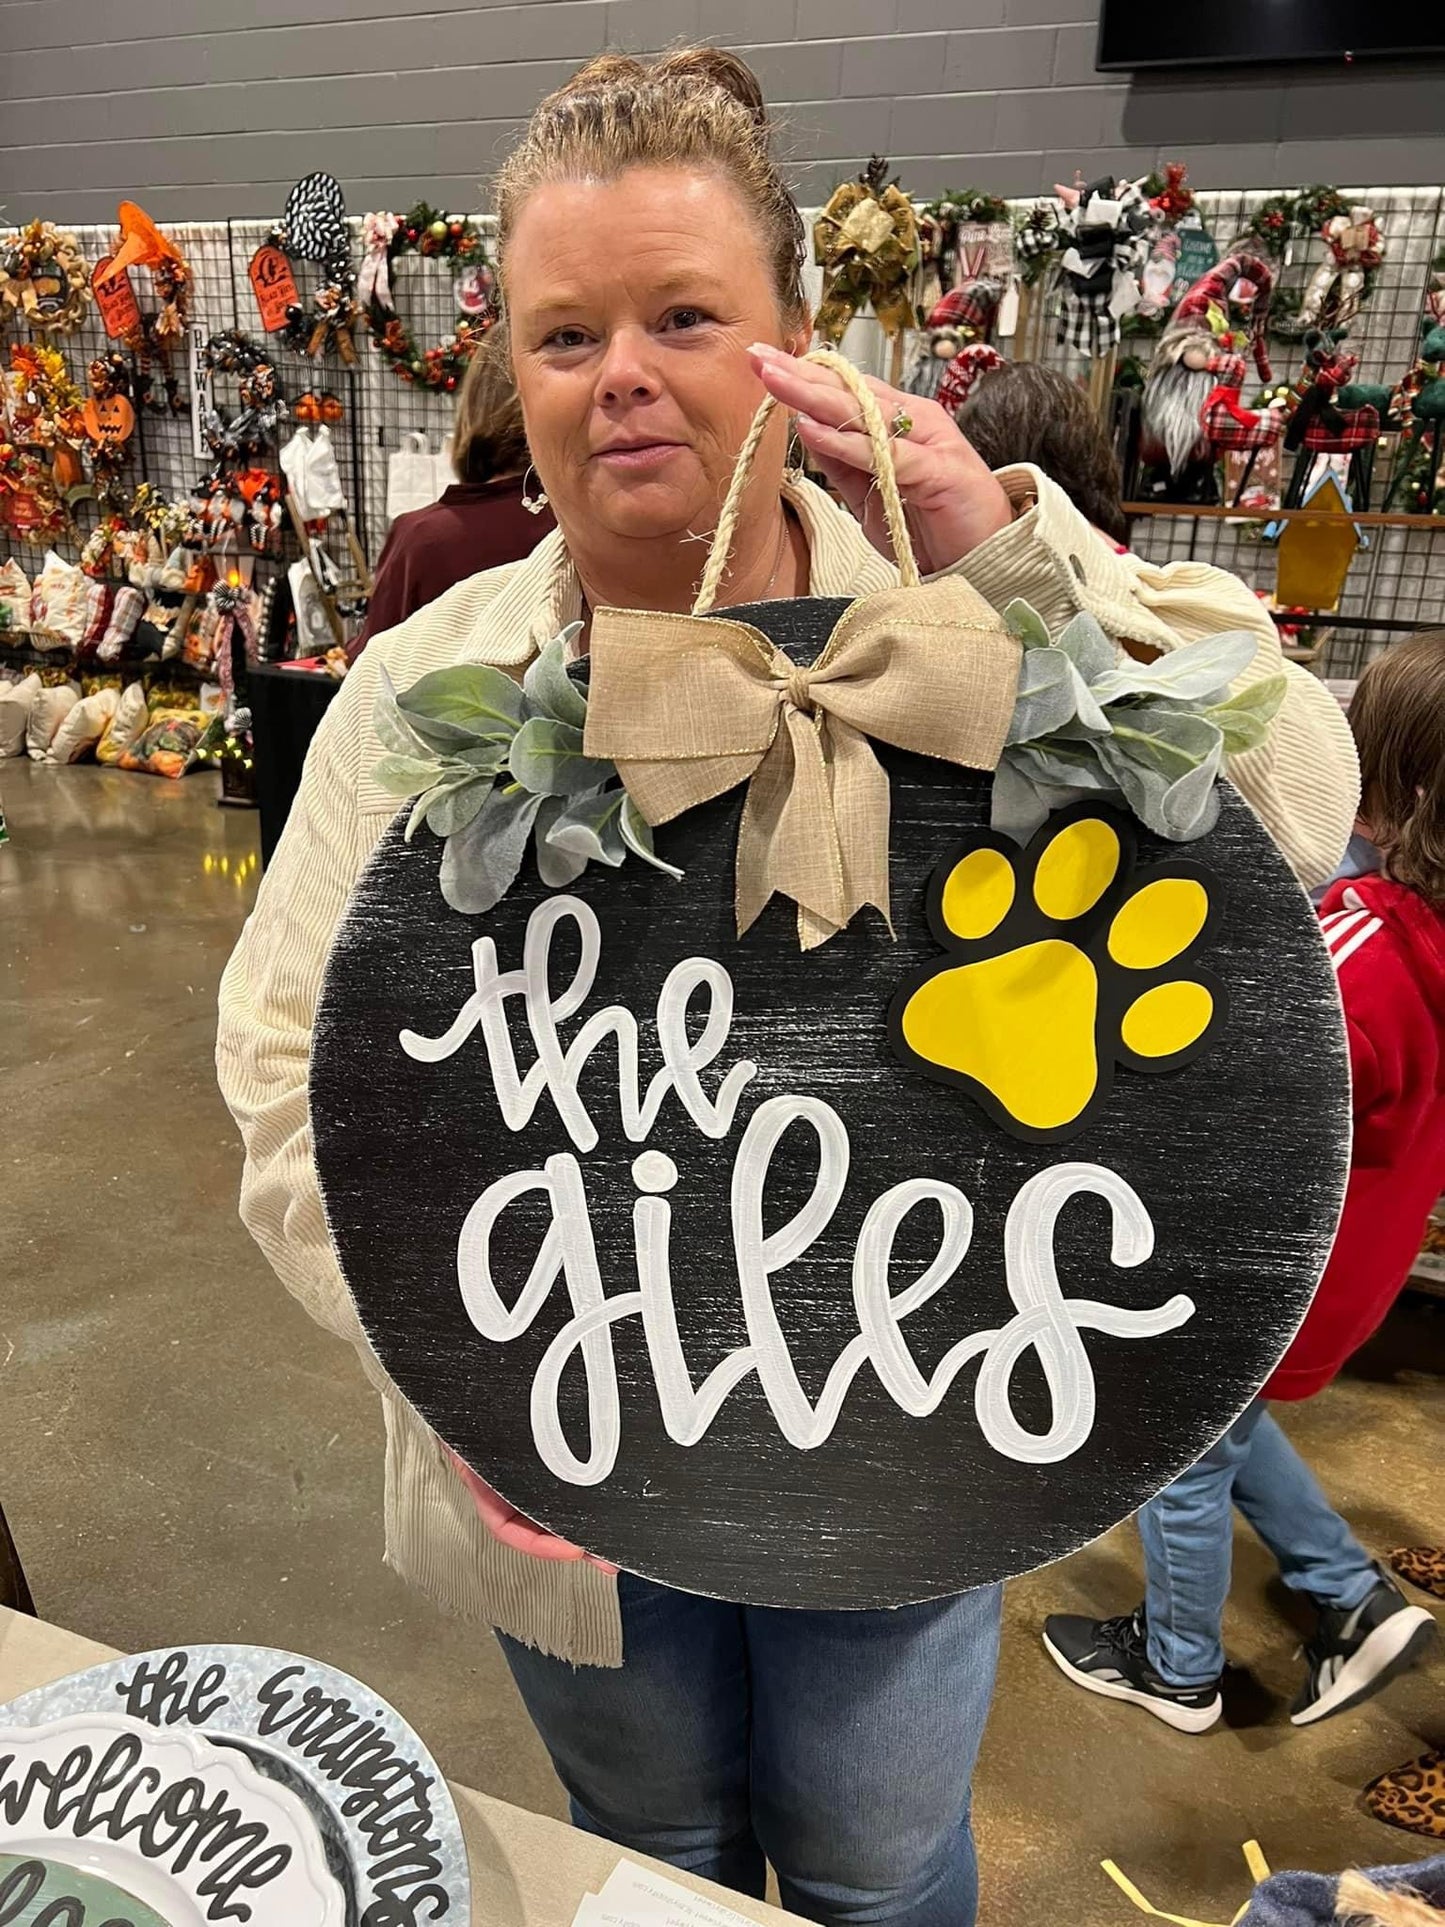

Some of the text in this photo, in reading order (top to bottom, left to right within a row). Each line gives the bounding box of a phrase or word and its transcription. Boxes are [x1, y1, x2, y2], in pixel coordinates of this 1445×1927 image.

[399, 895, 757, 1153] the
[457, 1096, 1196, 1487] giles
[116, 1651, 230, 1727] the
[0, 1732, 293, 1922] welcome
